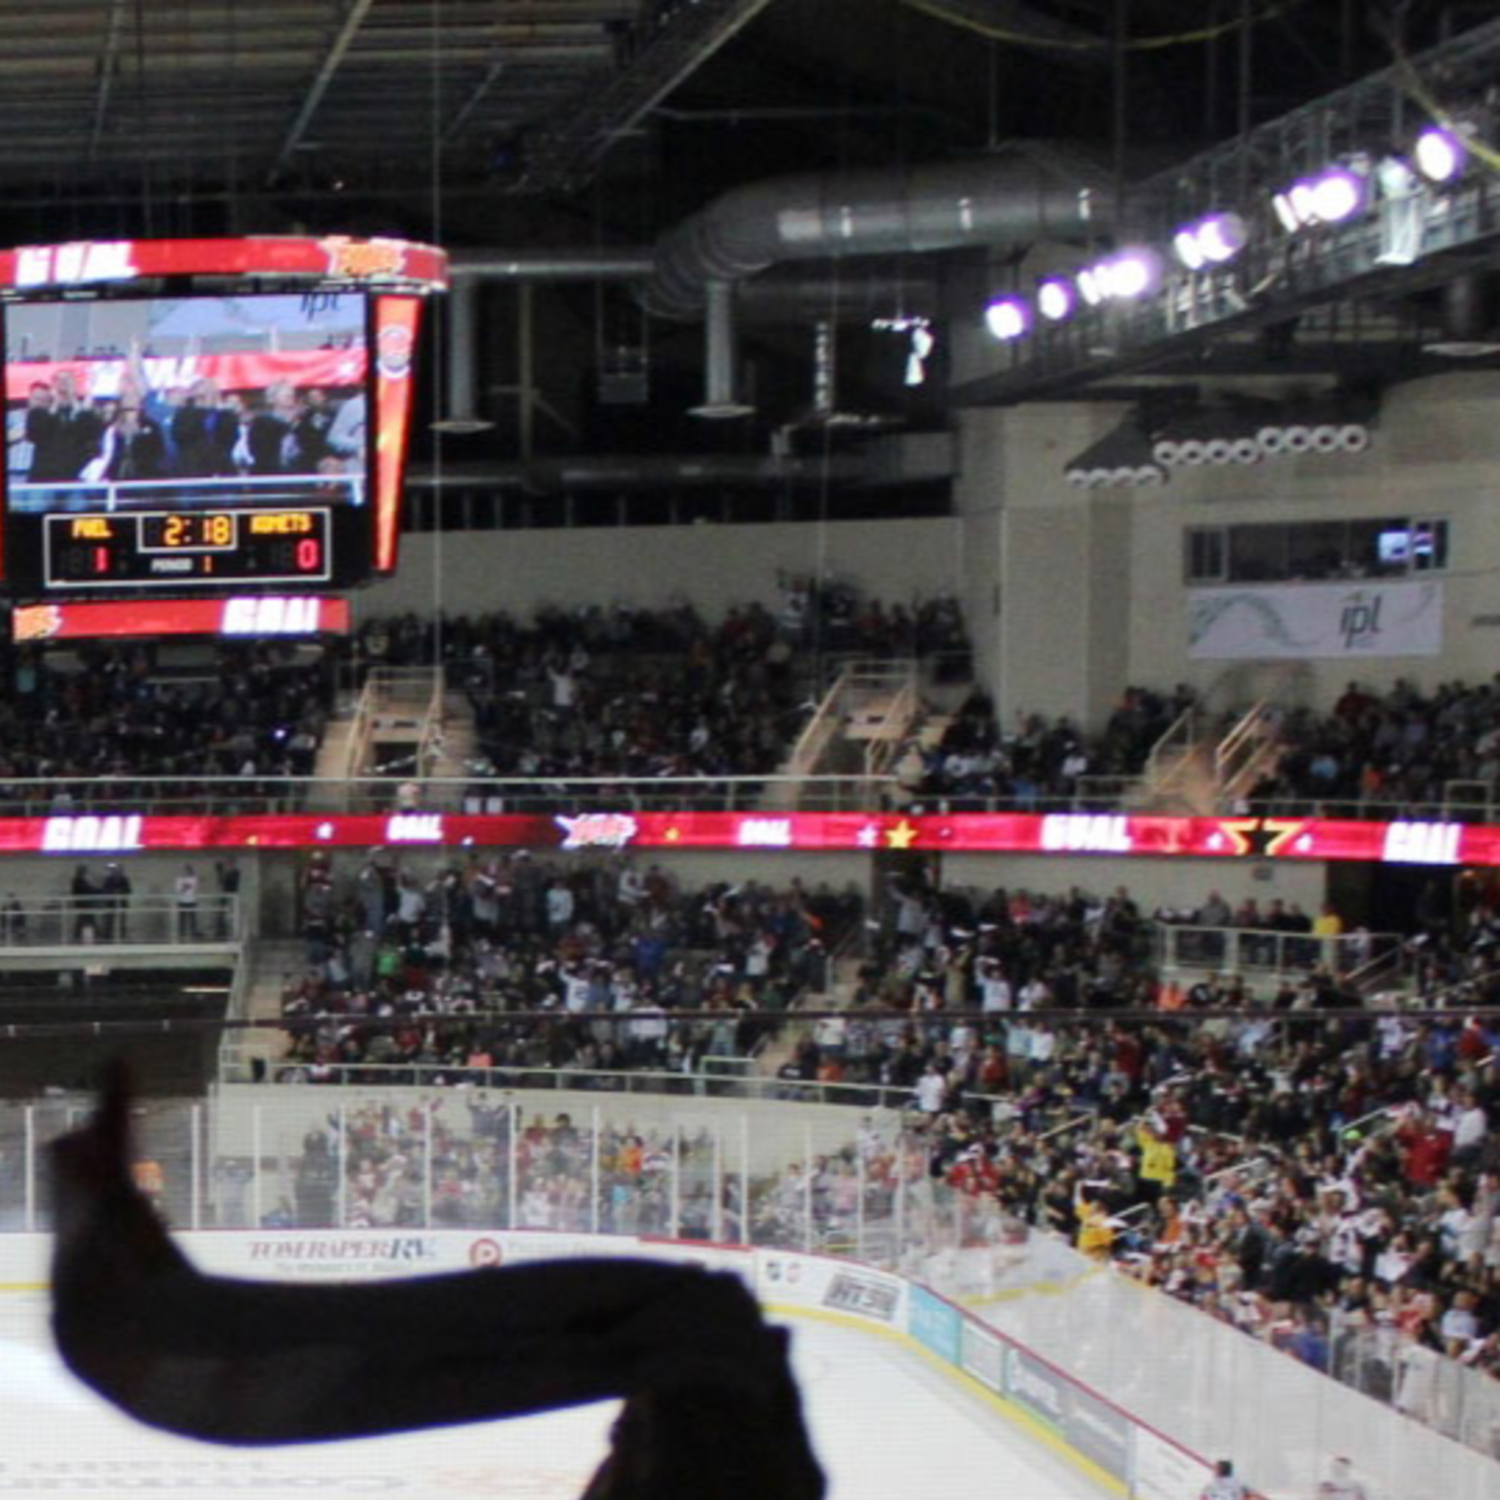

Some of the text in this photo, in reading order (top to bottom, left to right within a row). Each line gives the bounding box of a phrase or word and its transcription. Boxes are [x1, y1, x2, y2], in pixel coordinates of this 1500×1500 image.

[164, 516, 231, 545] 2:18
[96, 547, 108, 573] 1
[297, 539, 319, 570] 0
[1339, 593, 1383, 649] ipl
[42, 815, 142, 851] GOAL
